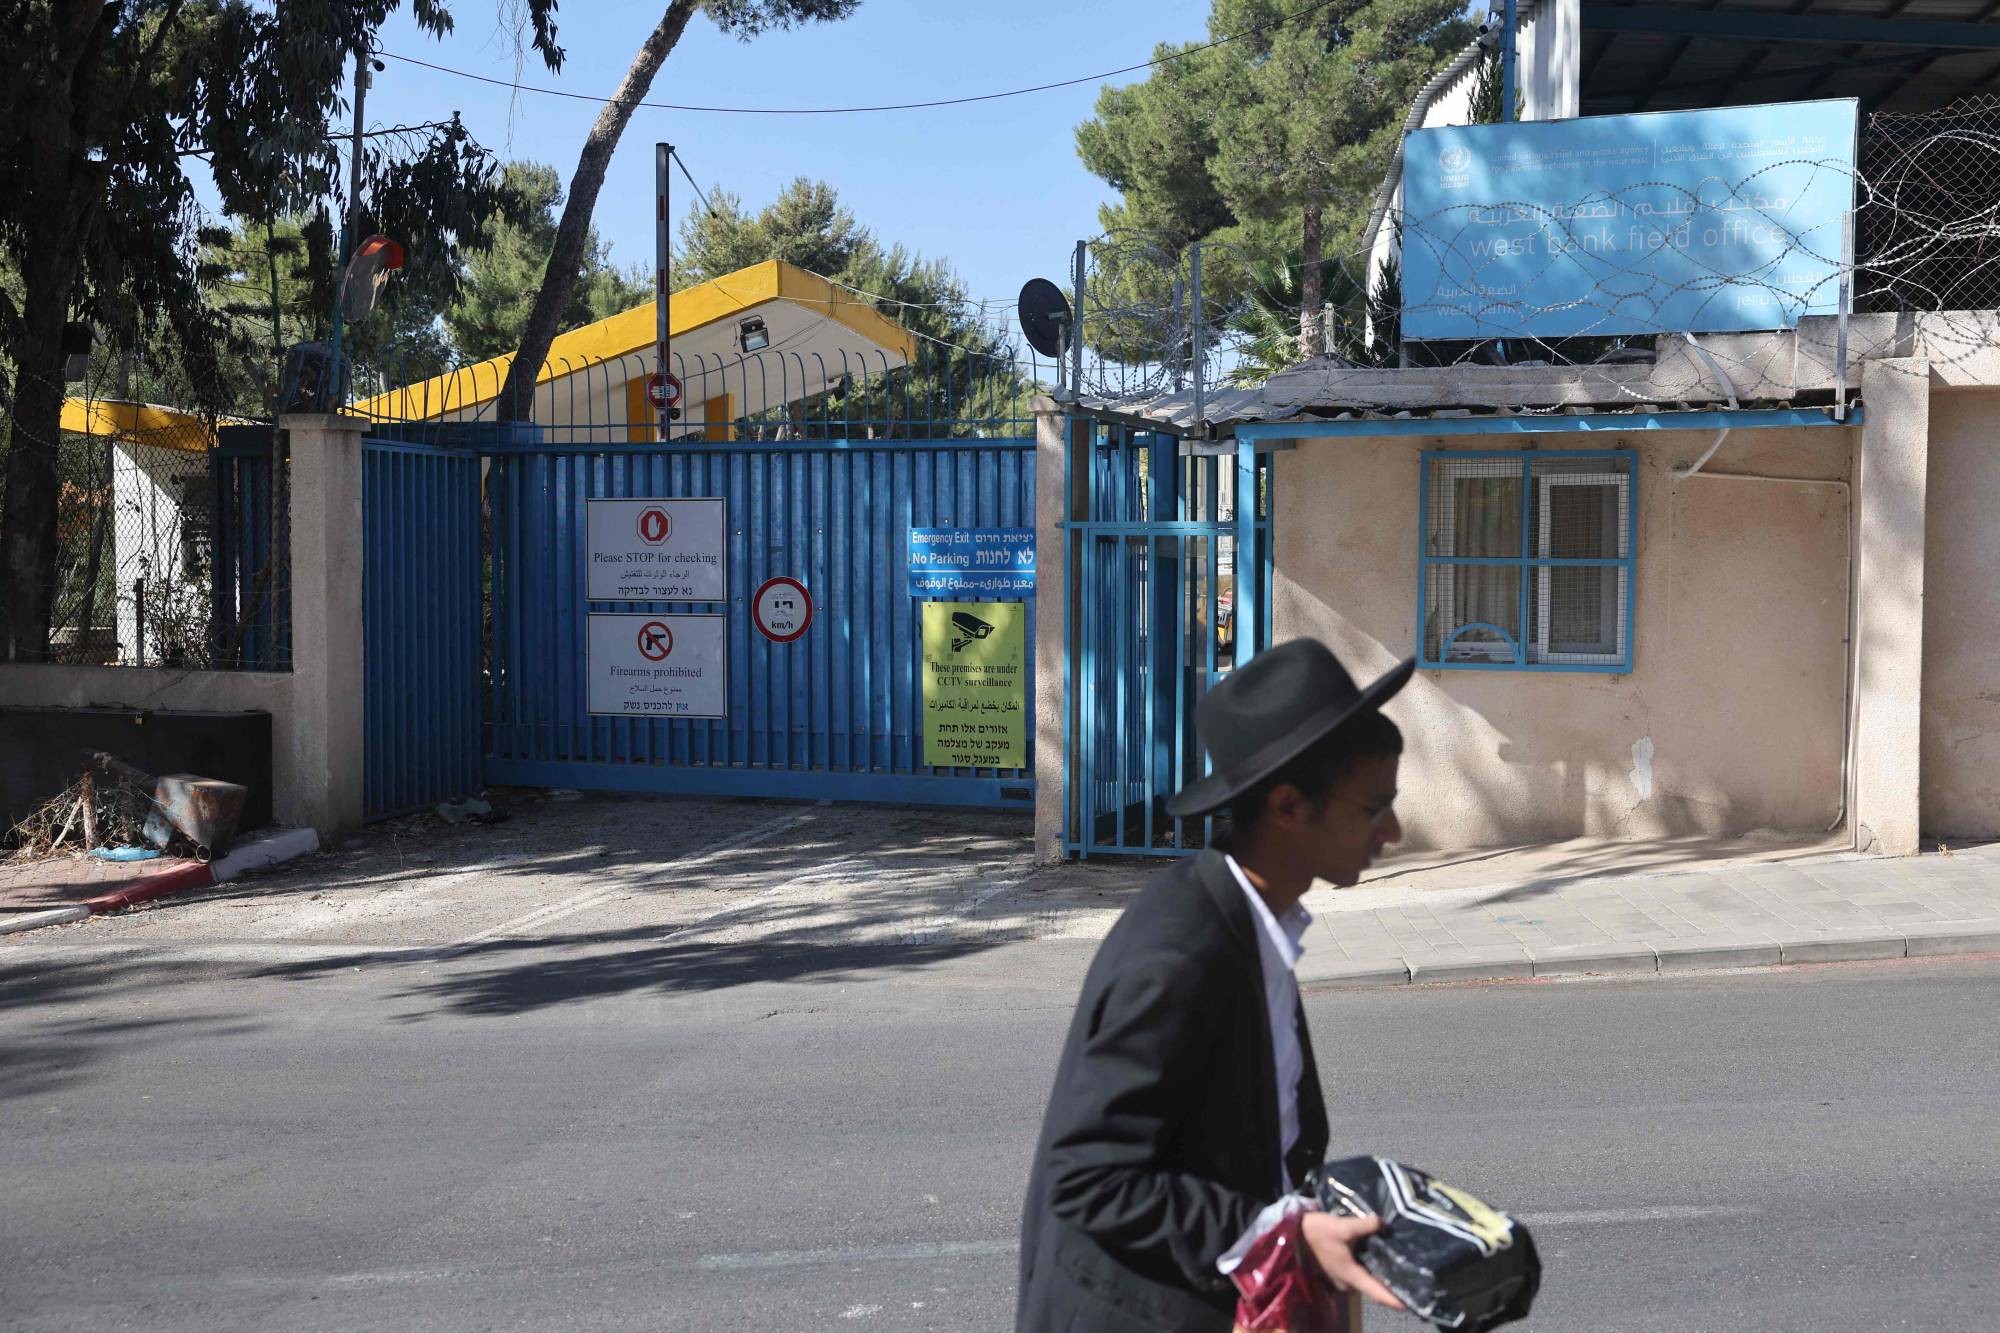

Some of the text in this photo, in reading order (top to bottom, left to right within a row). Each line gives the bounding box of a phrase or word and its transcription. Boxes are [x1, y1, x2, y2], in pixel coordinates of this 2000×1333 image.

[1469, 219, 1787, 257] west bank field office
[912, 532, 970, 546] Emergency Exit
[975, 533, 1034, 544] יציאת חרום
[594, 552, 717, 565] Please STOP for checking
[912, 552, 970, 567] No Parking
[975, 545, 1034, 565] לא לחנות
[915, 576, 947, 590] الوقوف
[1012, 578, 1034, 590] معبر
[617, 584, 693, 597] נא לעצור לבדיקה
[771, 621, 793, 629] km/h
[610, 666, 702, 679] Firearms prohibited
[930, 661, 1018, 675] These premises are under
[937, 676, 1013, 687] CCTV surveillance
[623, 701, 641, 711] נשק
[643, 700, 673, 711] להכניס
[938, 723, 1008, 734] אזורים אלו תחת
[936, 737, 1010, 751] מעקב של מצלמה
[951, 752, 1001, 764] במעגל סגור
